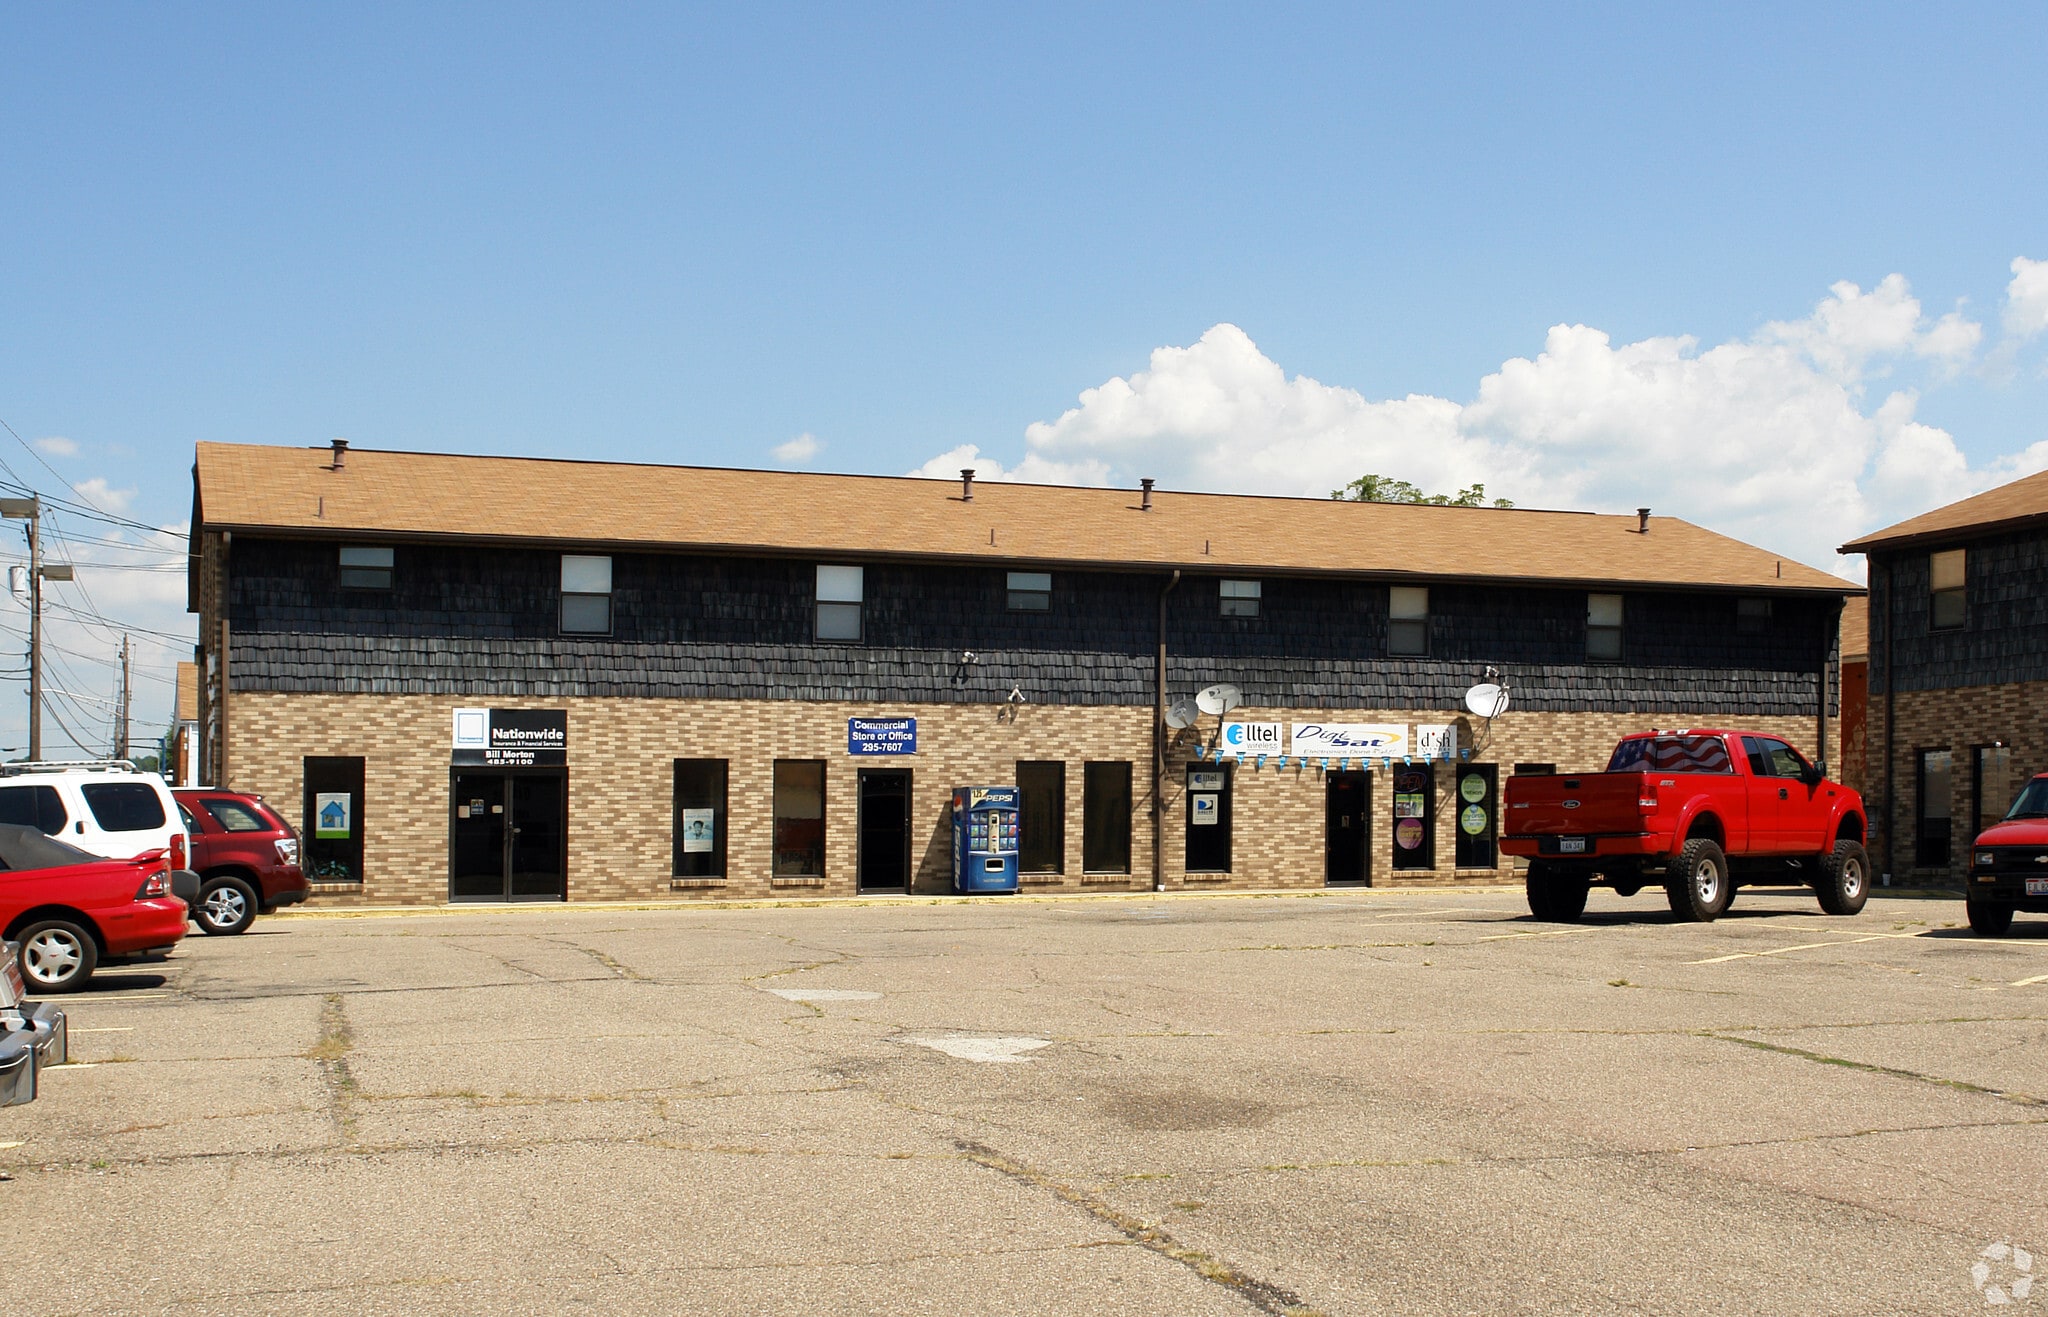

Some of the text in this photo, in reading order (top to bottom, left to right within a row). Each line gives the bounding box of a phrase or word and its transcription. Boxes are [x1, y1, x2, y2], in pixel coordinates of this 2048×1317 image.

[854, 720, 909, 729] Commercial
[492, 728, 564, 740] Nationwide
[852, 731, 876, 740] Store
[888, 731, 913, 740] Office
[1295, 725, 1350, 743] Digi
[1421, 731, 1451, 747] dish
[862, 742, 903, 752] 295-7607
[1247, 741, 1278, 749] wireless
[485, 750, 535, 758] Bill Morton
[986, 794, 1013, 802] PEPSI
